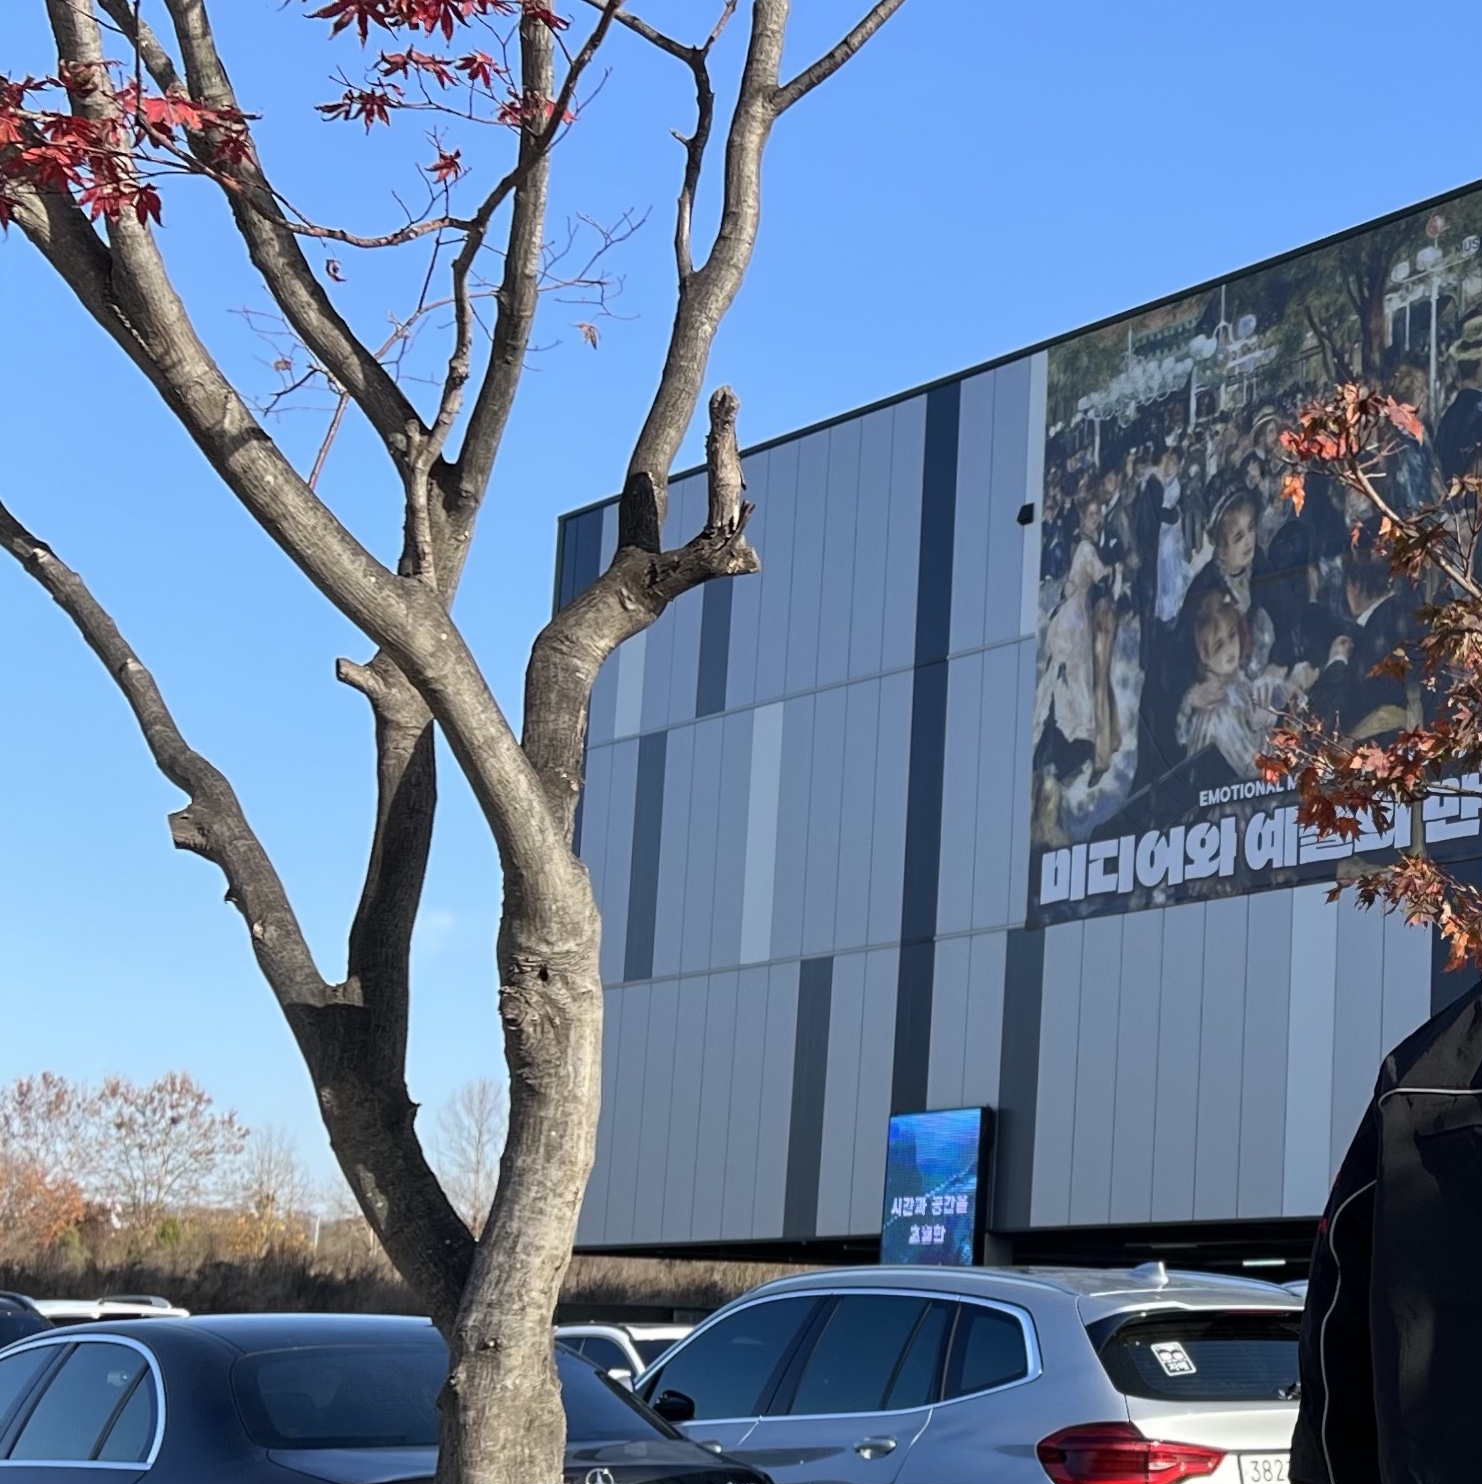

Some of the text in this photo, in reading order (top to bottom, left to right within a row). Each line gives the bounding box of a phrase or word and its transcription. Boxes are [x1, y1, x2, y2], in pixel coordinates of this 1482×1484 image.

[1199, 776, 1286, 807] EMOTIONAL
[1040, 816, 1238, 904] 미디어와
[890, 1194, 969, 1218] 시간과 공간을
[1249, 1458, 1290, 1483] 382
